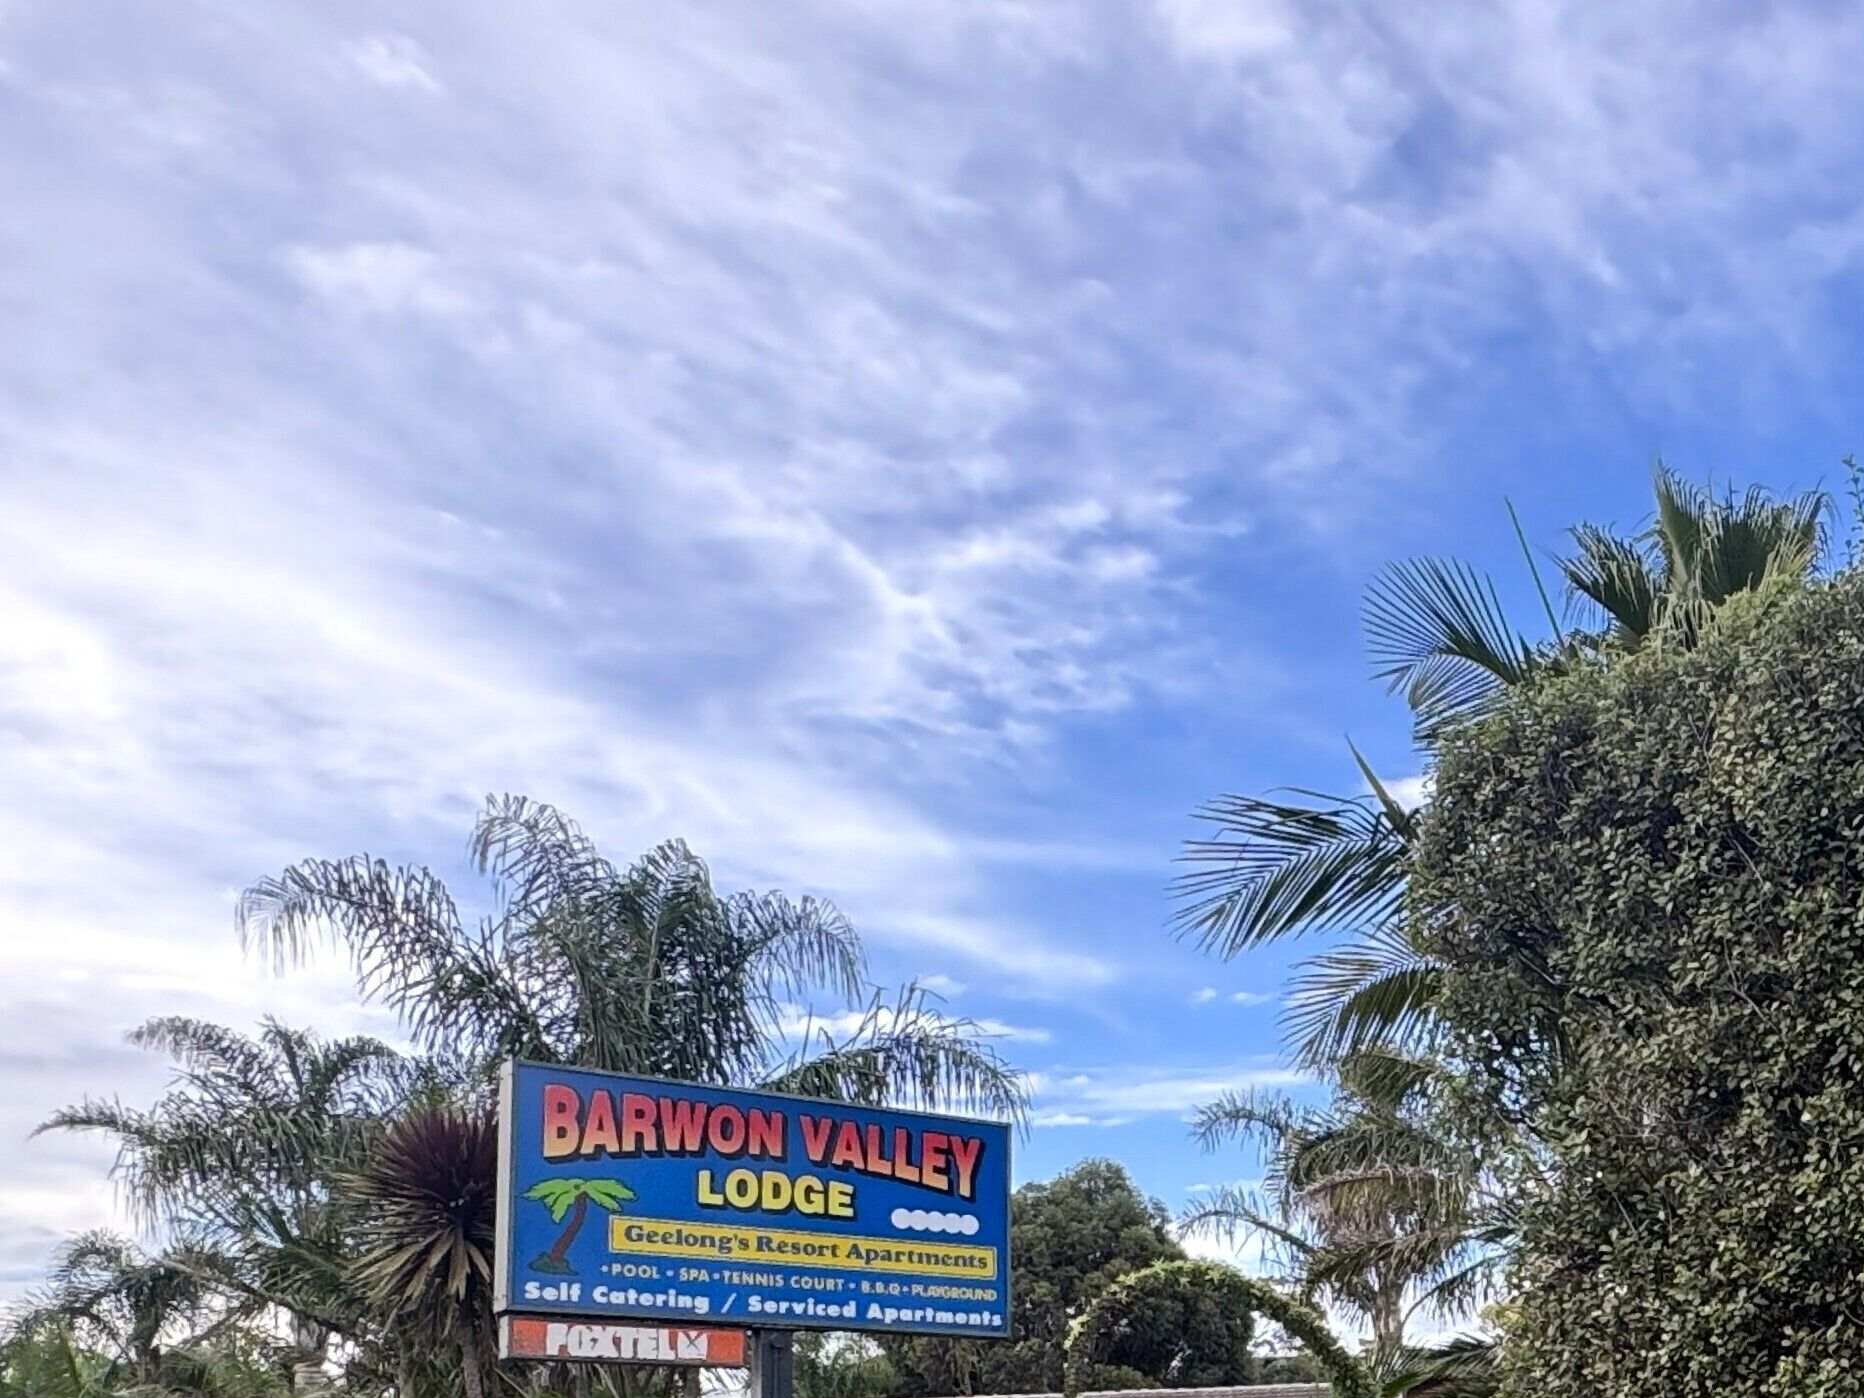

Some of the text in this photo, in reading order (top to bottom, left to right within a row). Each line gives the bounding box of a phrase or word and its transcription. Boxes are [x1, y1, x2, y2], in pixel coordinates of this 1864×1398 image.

[542, 1083, 981, 1198] BARWON VALLEY
[697, 1168, 855, 1218] LODGE
[624, 1225, 989, 1269] Geelong's Resort Apartments
[524, 1281, 582, 1303] Self
[592, 1285, 710, 1314] Catering
[747, 1294, 857, 1318] Serviced
[866, 1302, 1003, 1326] Apartments
[611, 1263, 660, 1279] POOL
[679, 1267, 710, 1283] SPA
[722, 1269, 785, 1287] TENNIS
[790, 1275, 845, 1292] COURT
[911, 1284, 998, 1302] PLAYGROUND
